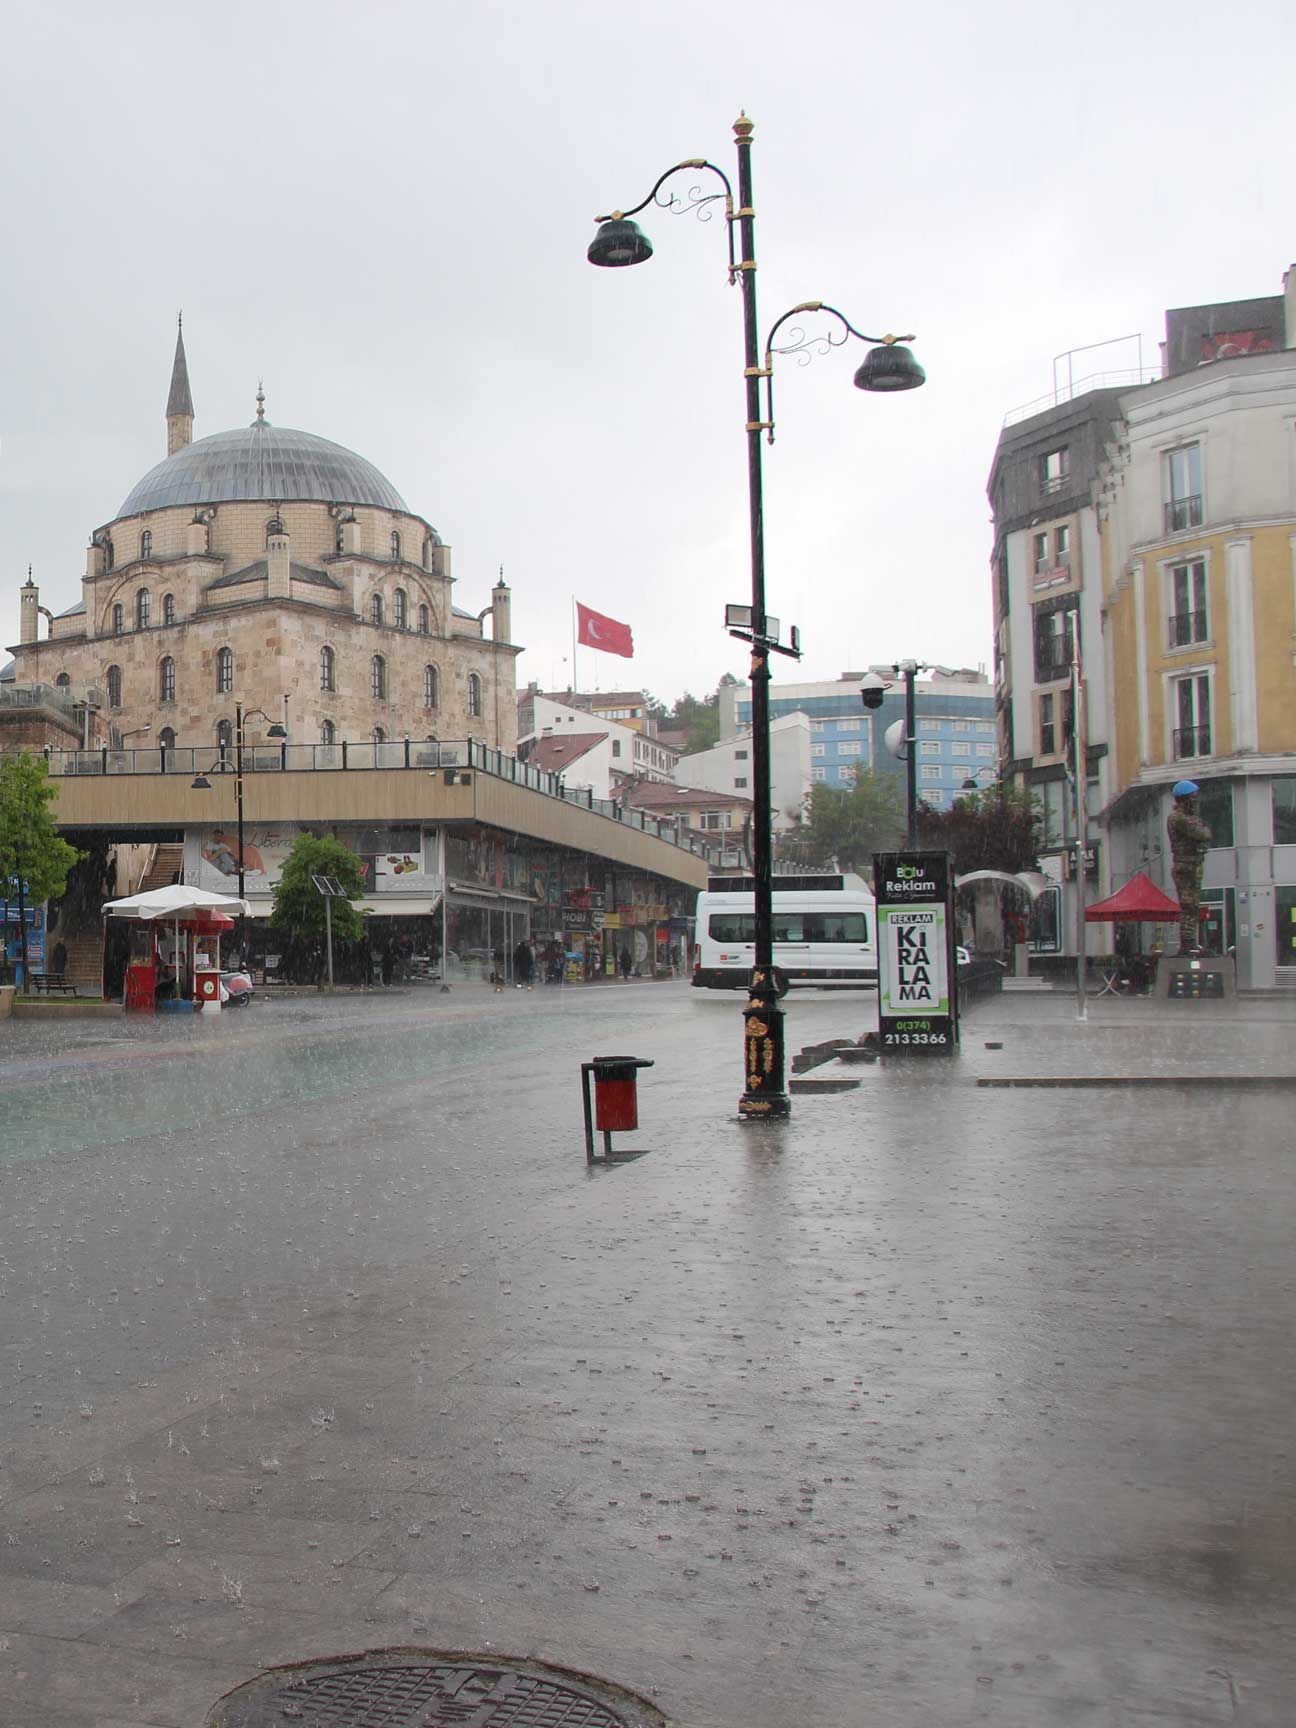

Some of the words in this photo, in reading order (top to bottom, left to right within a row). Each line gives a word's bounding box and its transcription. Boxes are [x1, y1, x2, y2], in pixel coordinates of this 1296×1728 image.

[896, 865, 924, 879] Bolu
[886, 880, 936, 892] Reklam
[892, 914, 932, 924] REKLAM
[896, 1021, 931, 1031] 0(374)
